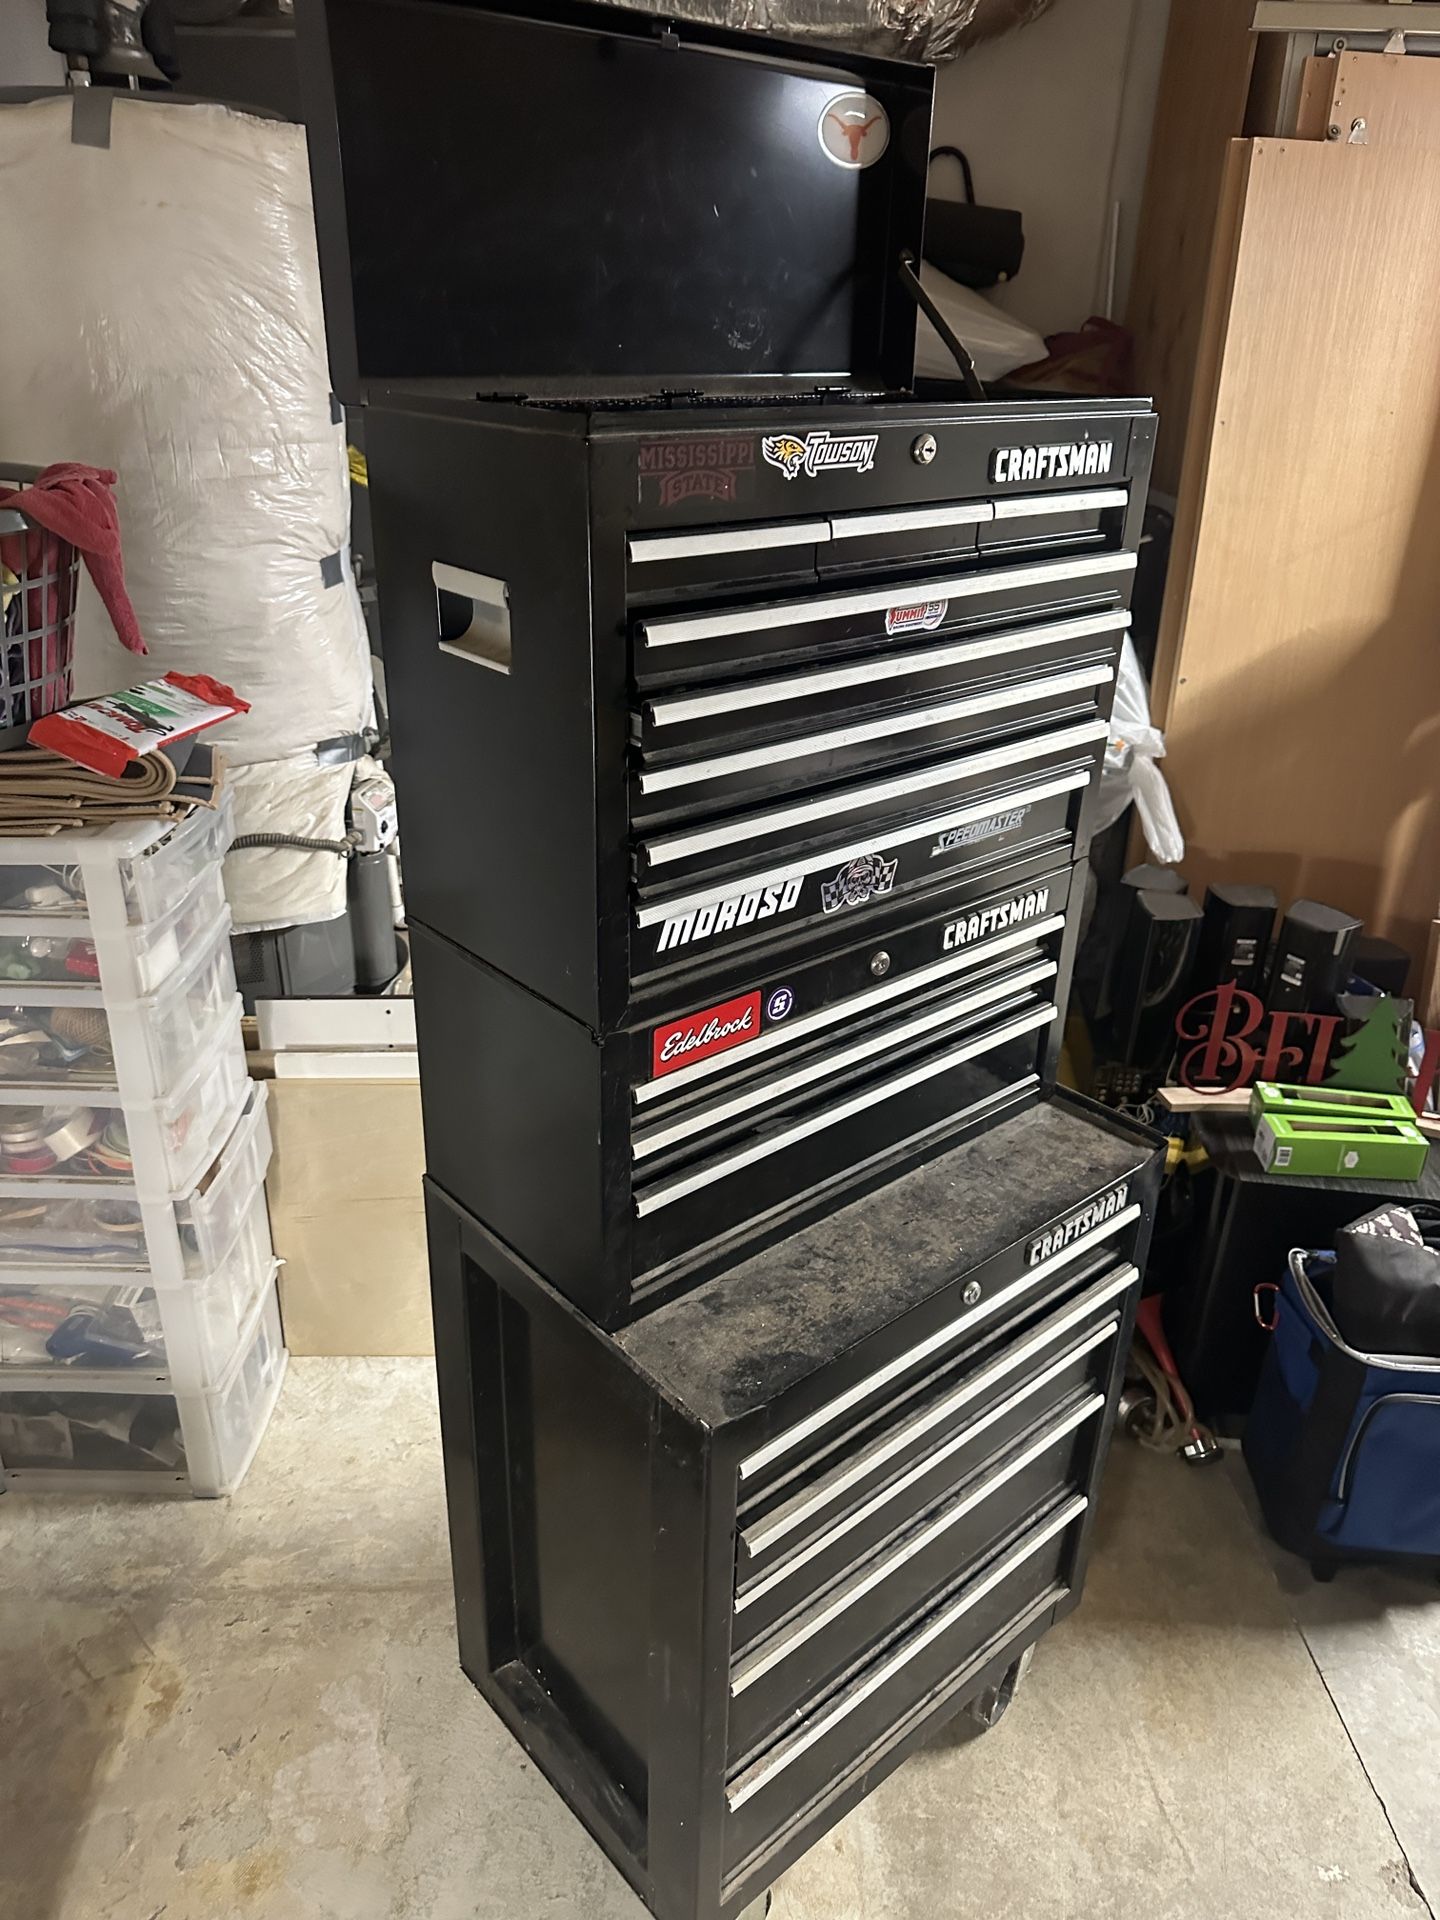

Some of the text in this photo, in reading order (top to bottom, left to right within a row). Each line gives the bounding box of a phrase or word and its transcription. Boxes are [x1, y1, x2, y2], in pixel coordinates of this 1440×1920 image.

[640, 441, 754, 470] MISSISSIPPI
[806, 434, 876, 473] TOWSON
[994, 442, 1113, 483] CRAFTSMAN
[672, 473, 724, 498] STATE
[931, 808, 1026, 856] SPEEDMASTER
[656, 875, 805, 953] MOROSO
[943, 888, 1050, 951] CRAFTSMAN
[659, 1006, 753, 1062] Edelbrock
[1030, 1186, 1128, 1267] CRAFTSMAN
